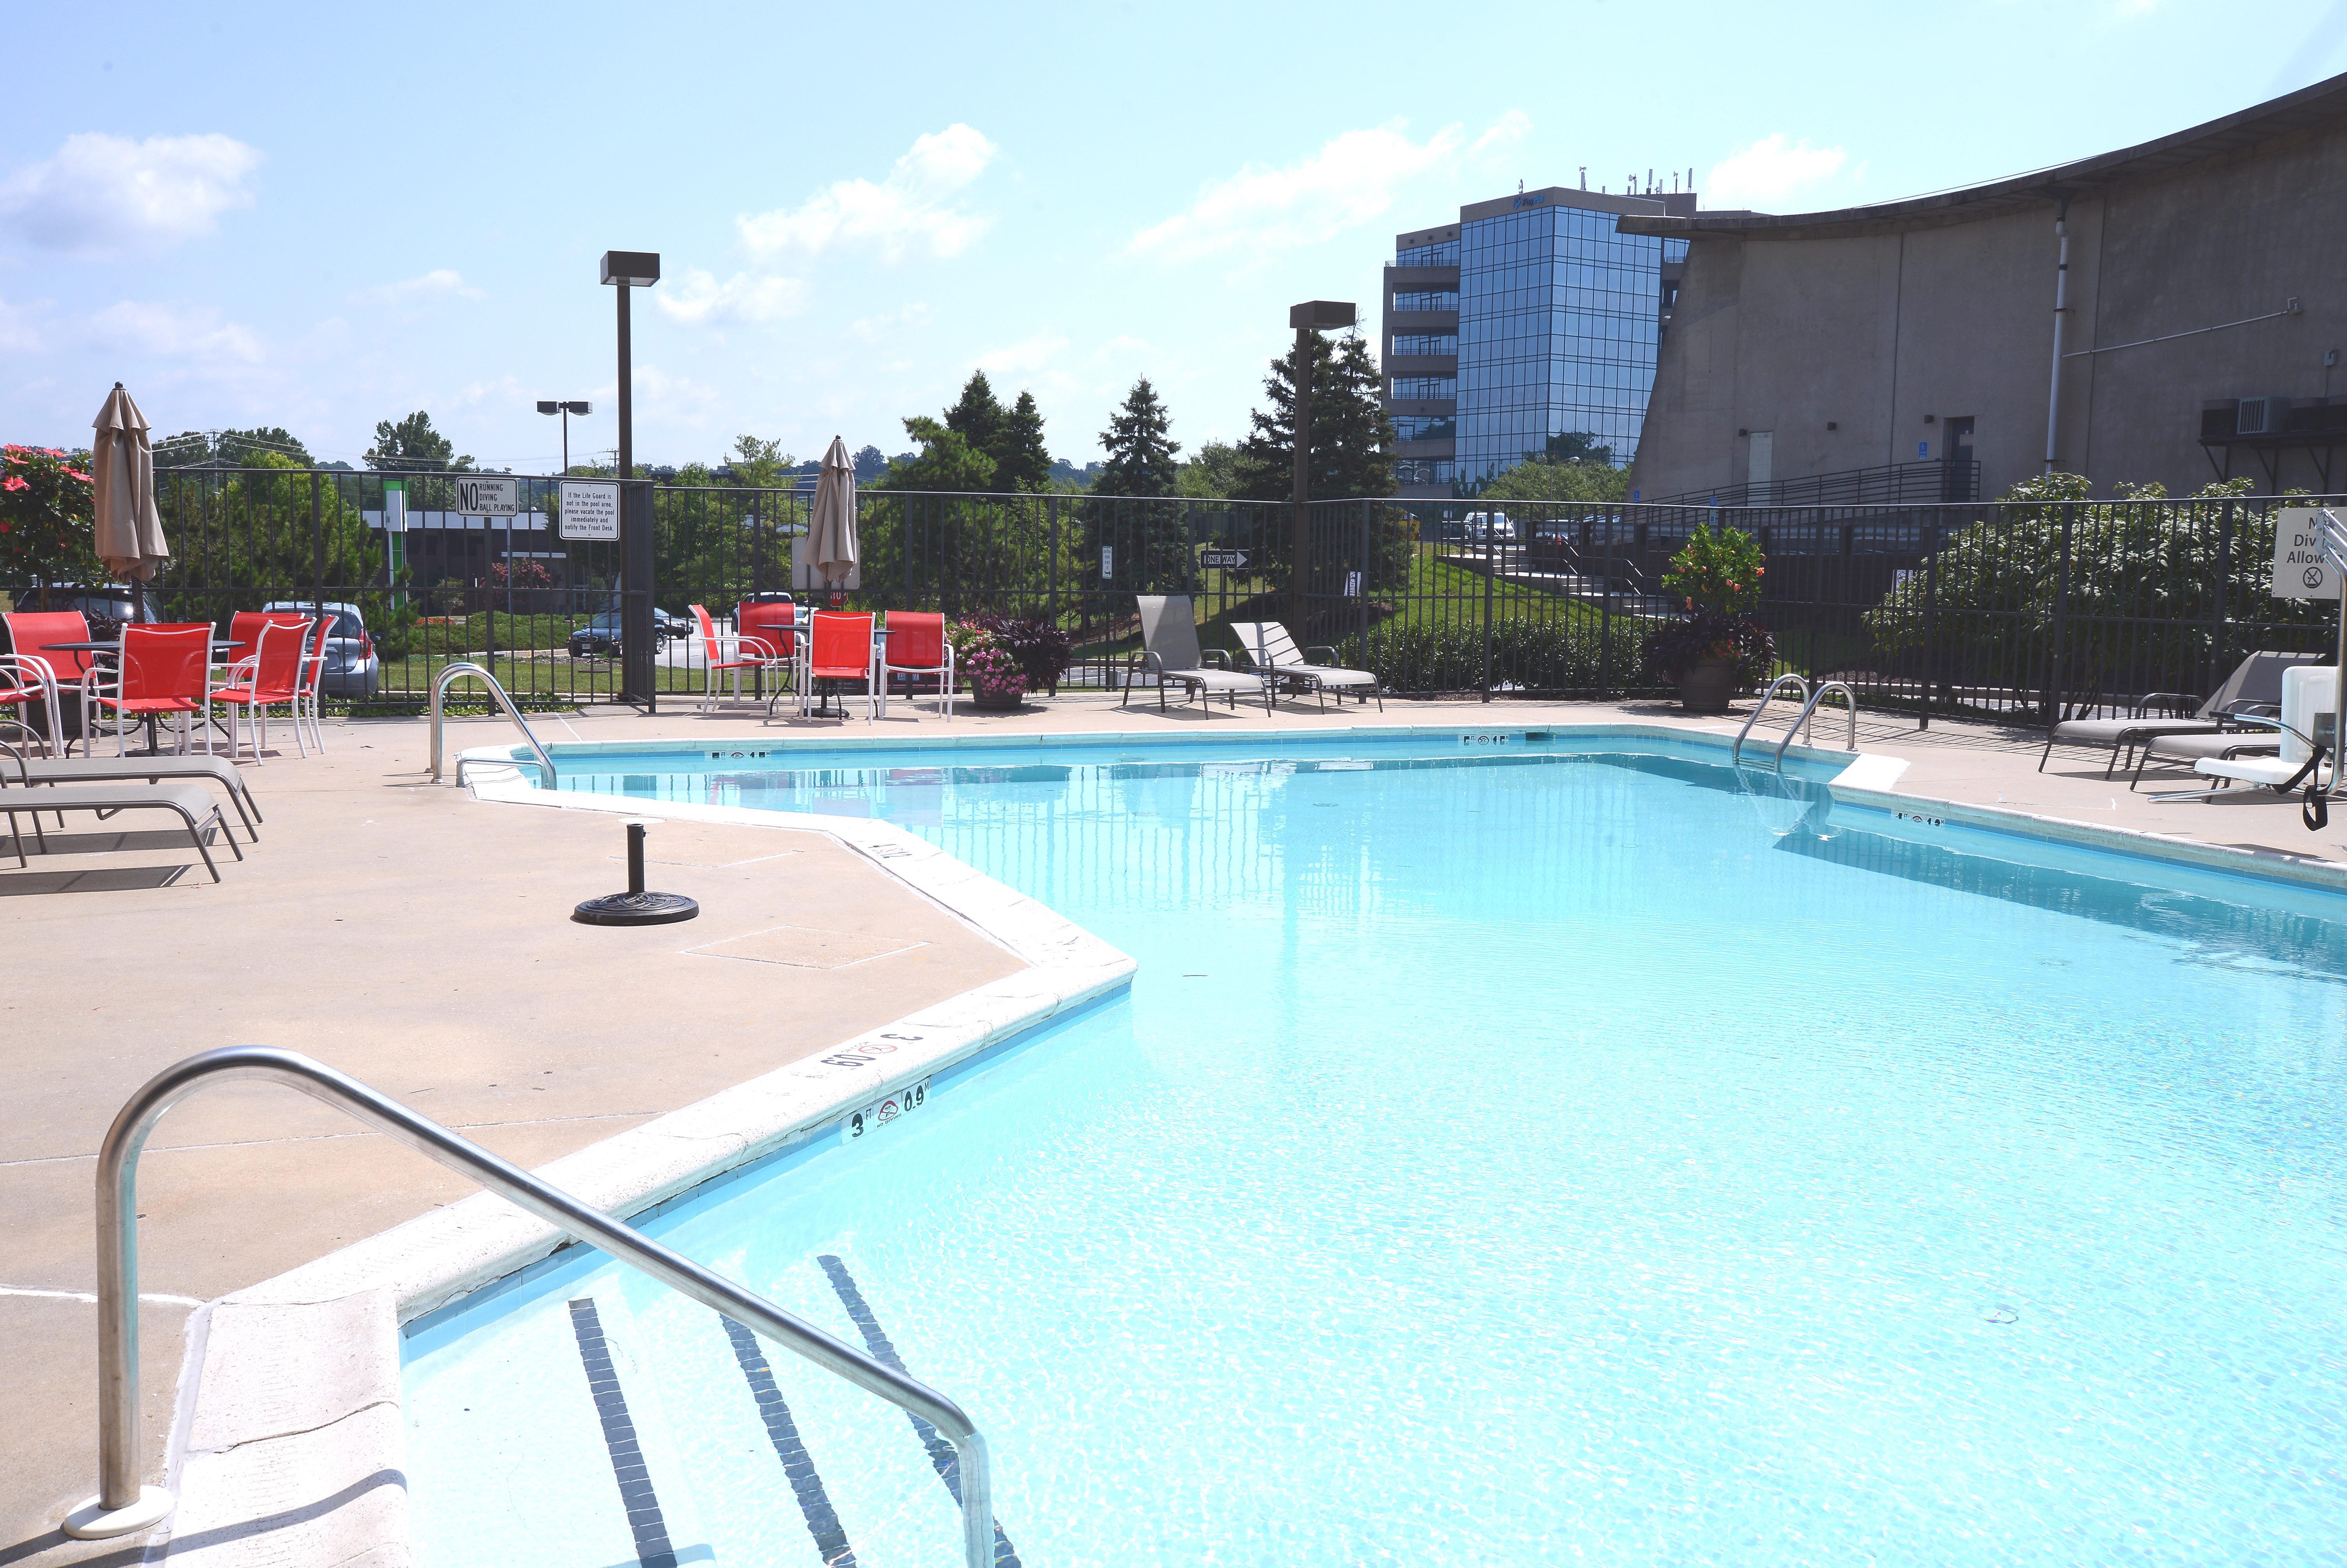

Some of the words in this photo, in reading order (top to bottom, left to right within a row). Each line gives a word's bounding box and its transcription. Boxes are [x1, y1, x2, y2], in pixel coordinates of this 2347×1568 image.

[1523, 195, 1544, 206] PayPal
[460, 483, 478, 511] NO
[852, 1113, 864, 1137] 3
[866, 1108, 872, 1121] FT
[904, 1085, 924, 1112] 0.9
[925, 1081, 929, 1091] M
[885, 1113, 902, 1124] DIVING
